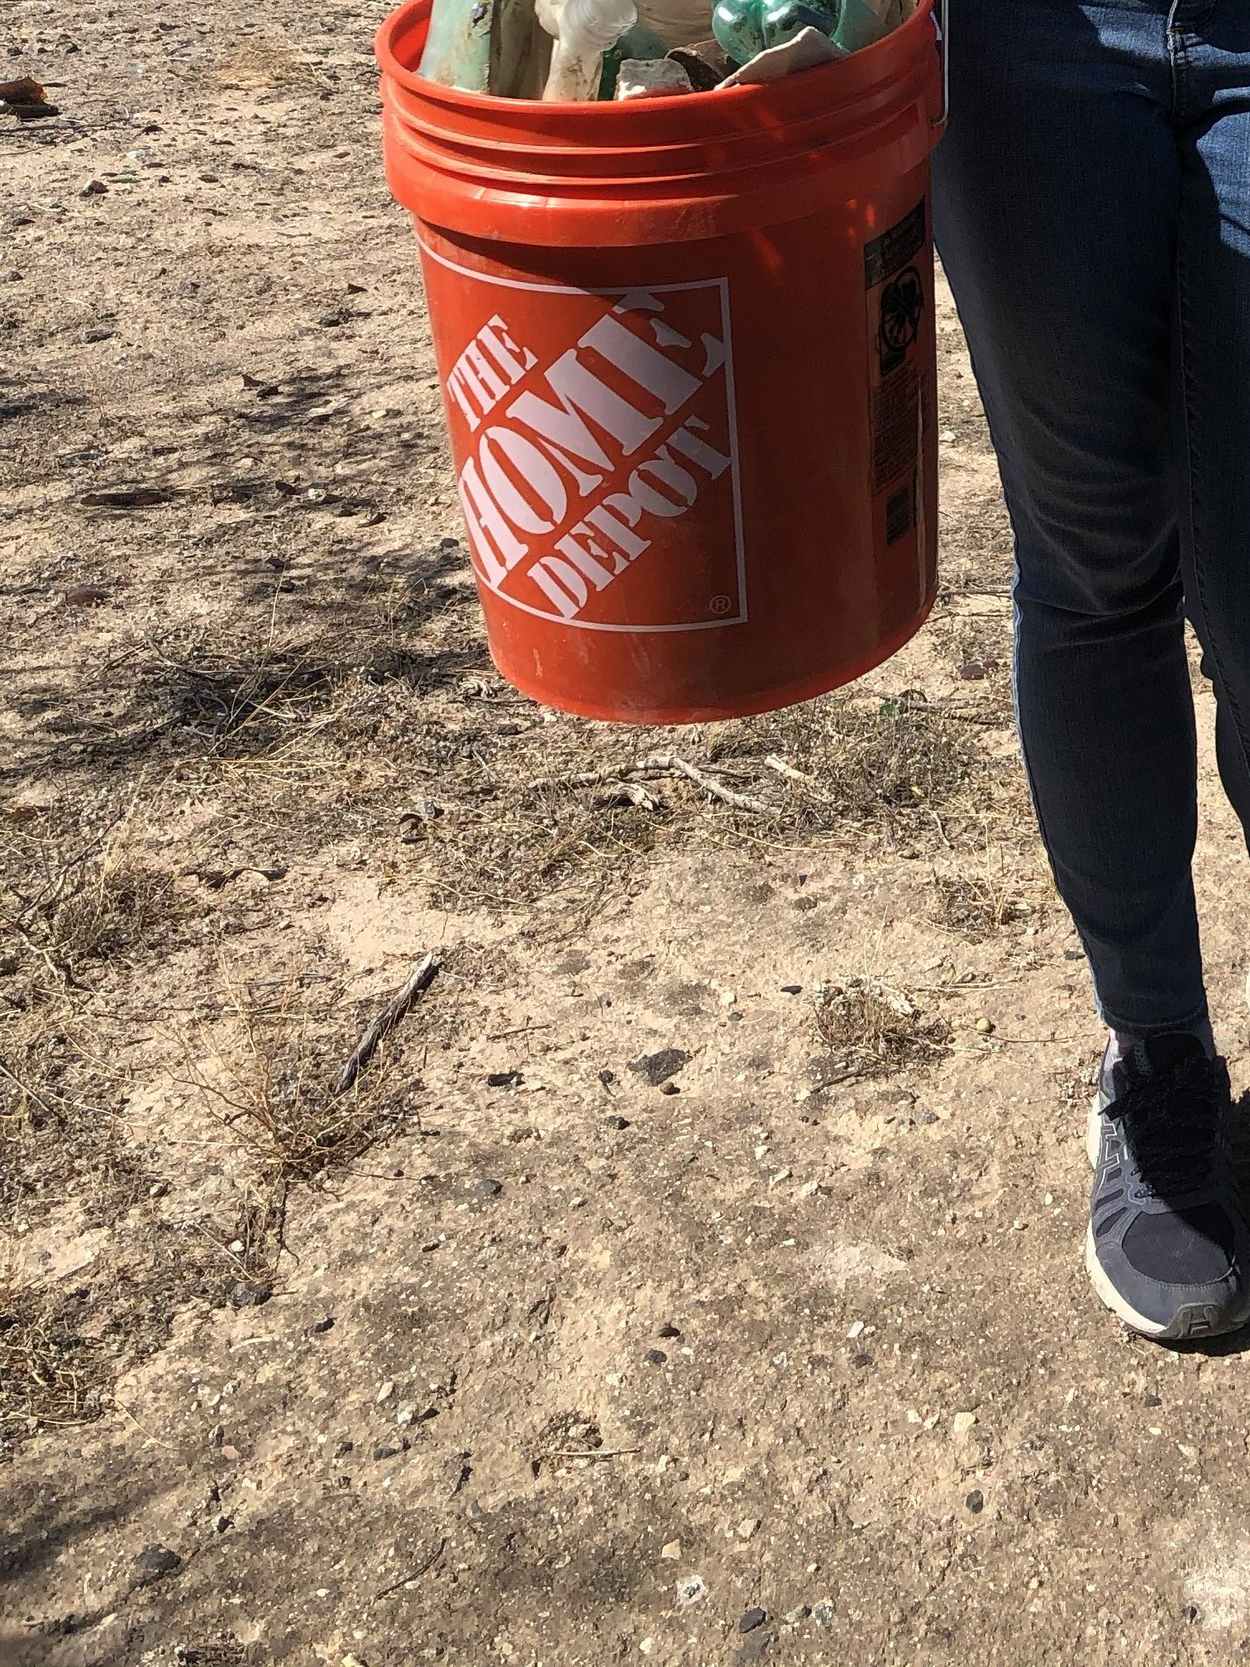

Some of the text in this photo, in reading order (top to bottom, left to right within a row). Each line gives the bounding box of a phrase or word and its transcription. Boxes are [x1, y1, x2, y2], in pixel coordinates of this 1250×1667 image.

[447, 314, 539, 432] THE
[458, 291, 729, 589] HOME
[526, 414, 732, 619] DEPOT
